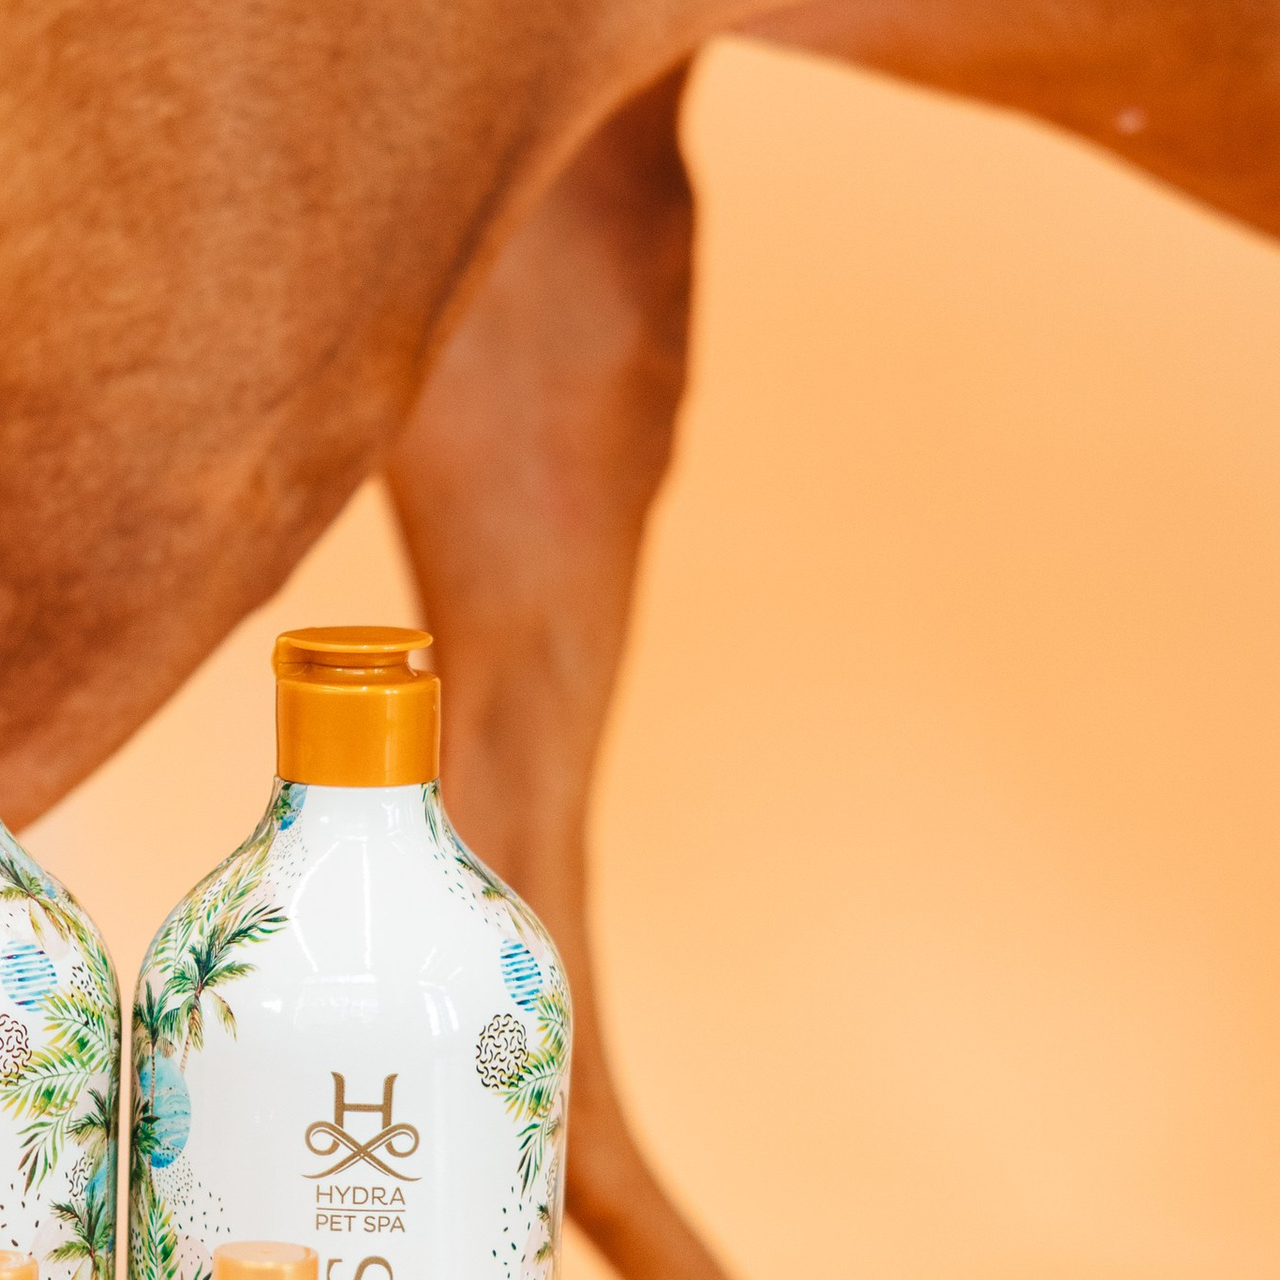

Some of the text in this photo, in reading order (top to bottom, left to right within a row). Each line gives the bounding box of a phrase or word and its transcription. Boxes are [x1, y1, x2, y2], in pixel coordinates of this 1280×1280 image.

[316, 1184, 406, 1206] HYDRA
[315, 1213, 406, 1233] PET SPA
